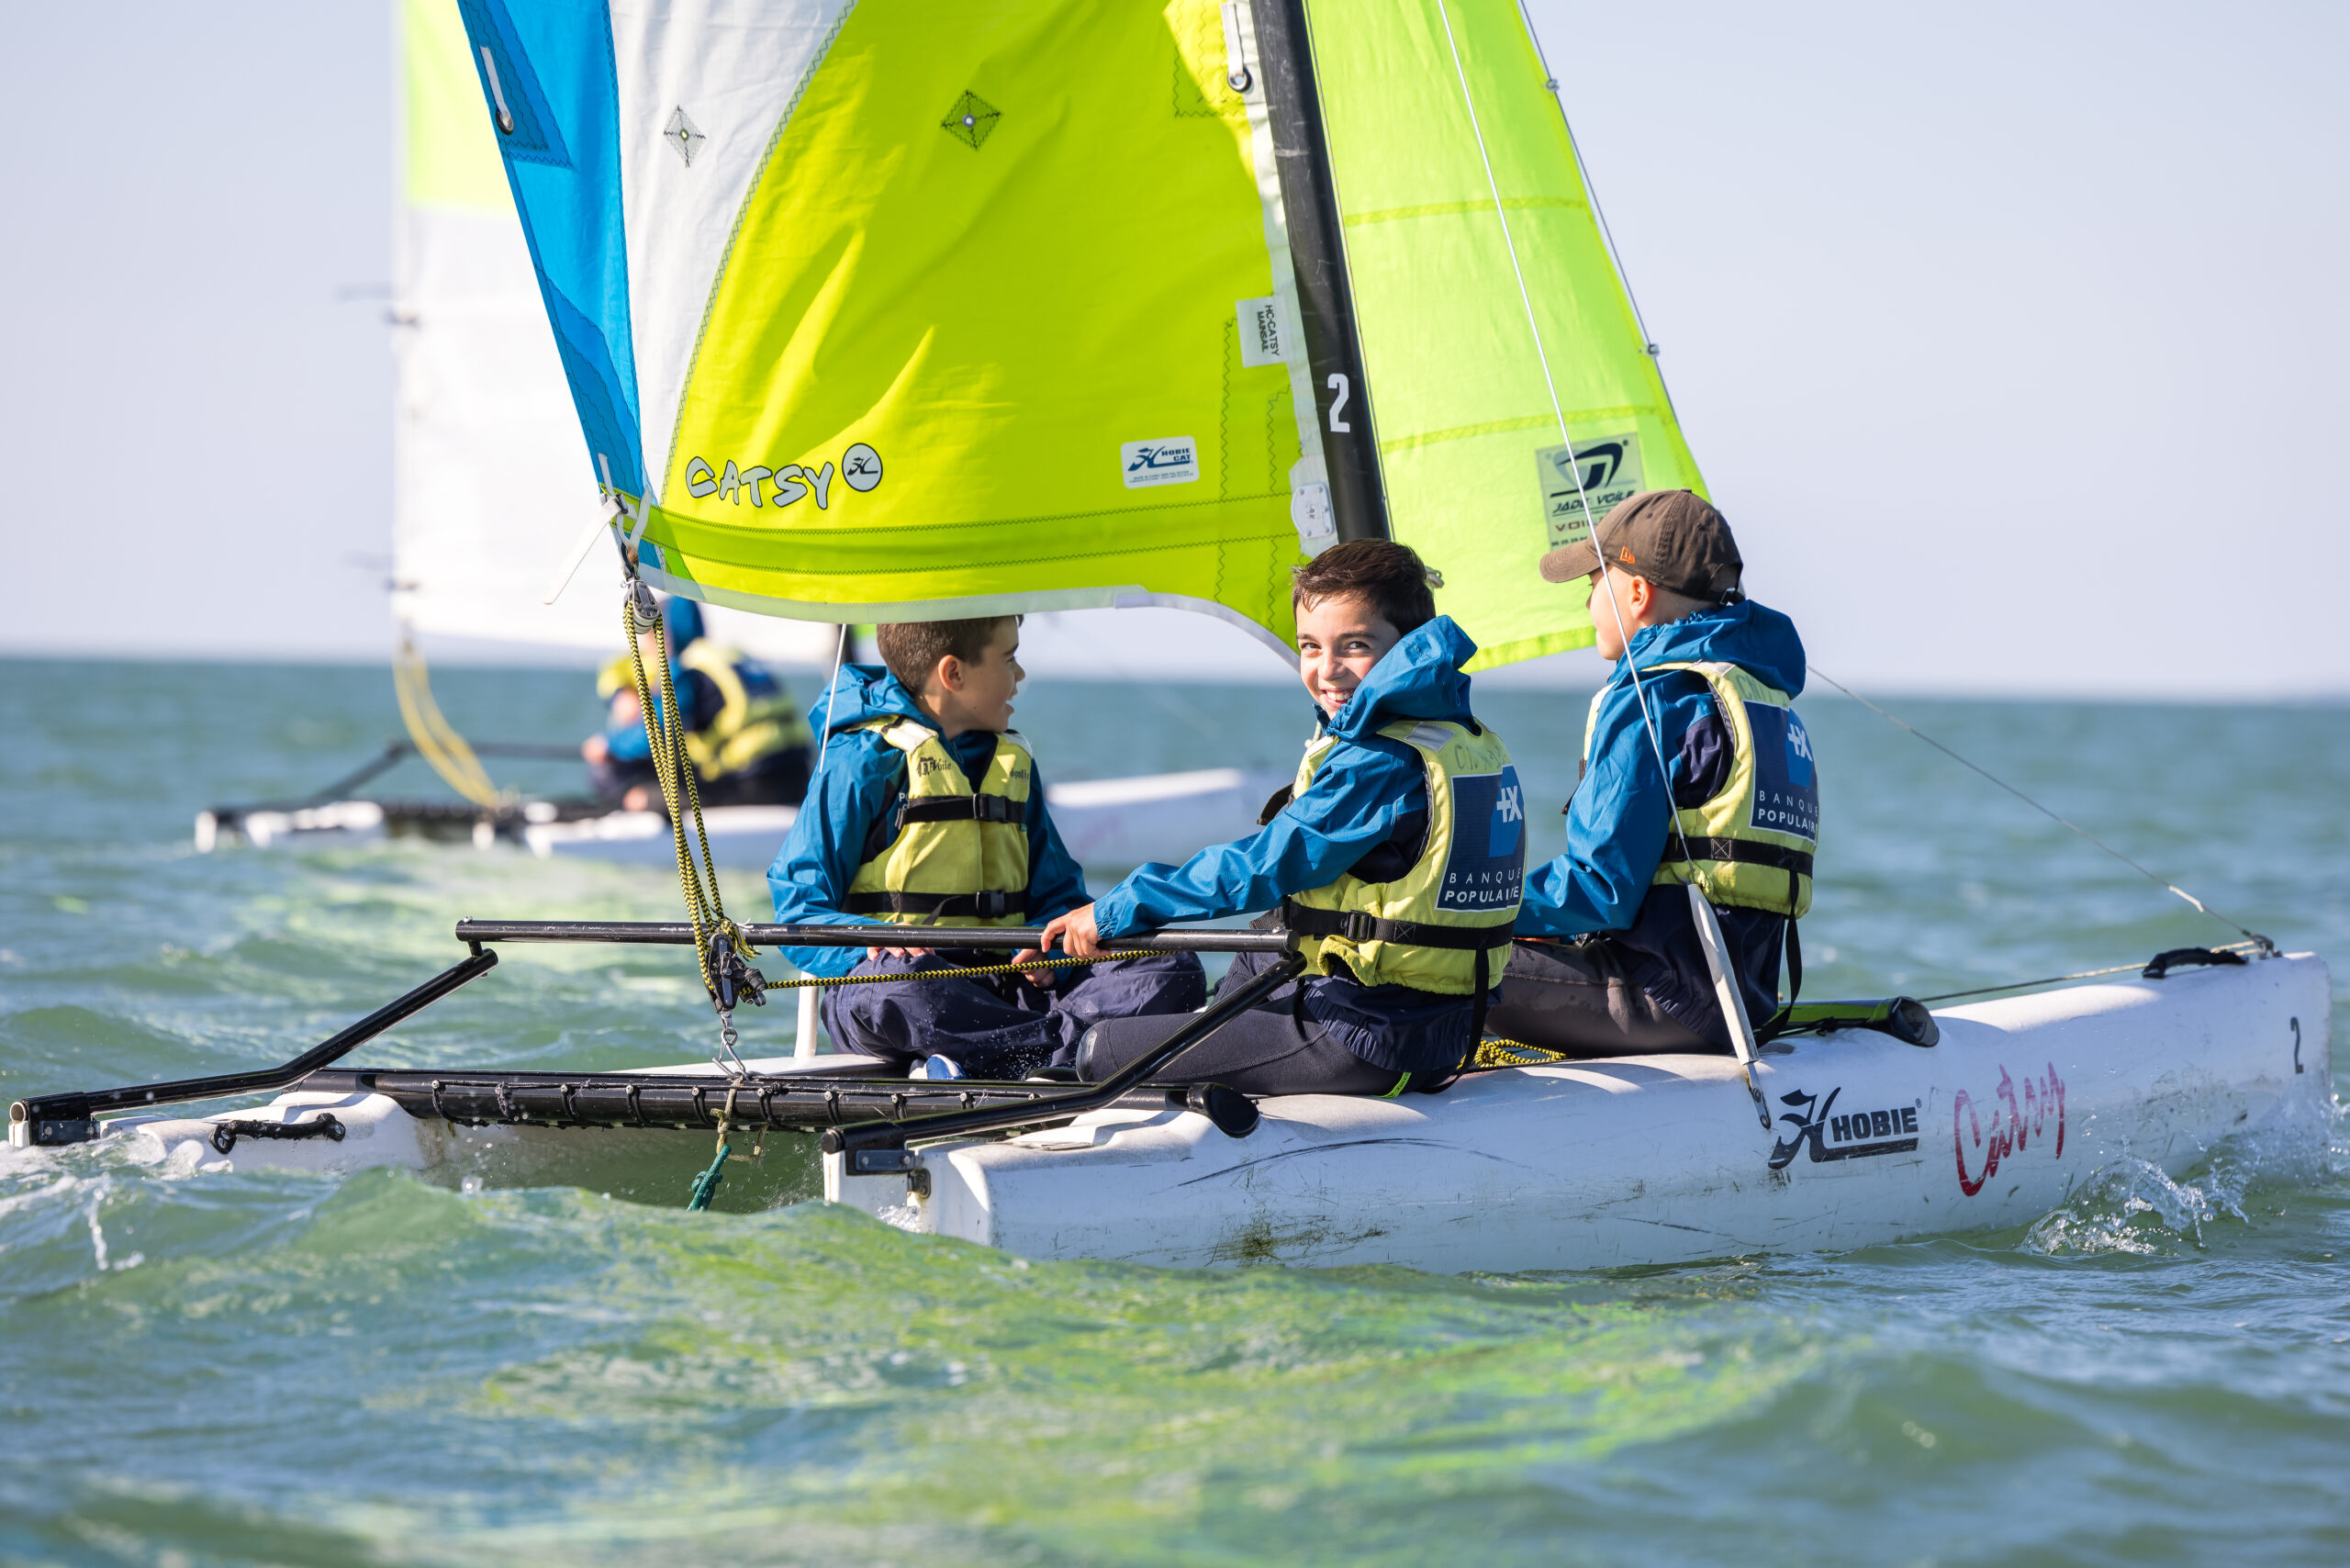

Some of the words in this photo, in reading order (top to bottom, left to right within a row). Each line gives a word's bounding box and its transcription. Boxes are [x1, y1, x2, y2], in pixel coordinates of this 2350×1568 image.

[1257, 310, 1270, 353] MAINSAIL
[1264, 304, 1281, 356] HC-CATSY
[1326, 373, 1350, 432] 2
[1161, 447, 1190, 456] HOBIE
[685, 455, 834, 510] CATSY
[1759, 790, 1818, 818] BANQUE
[2290, 1016, 2304, 1074] 2
[1830, 1105, 1919, 1143] HOBIE
